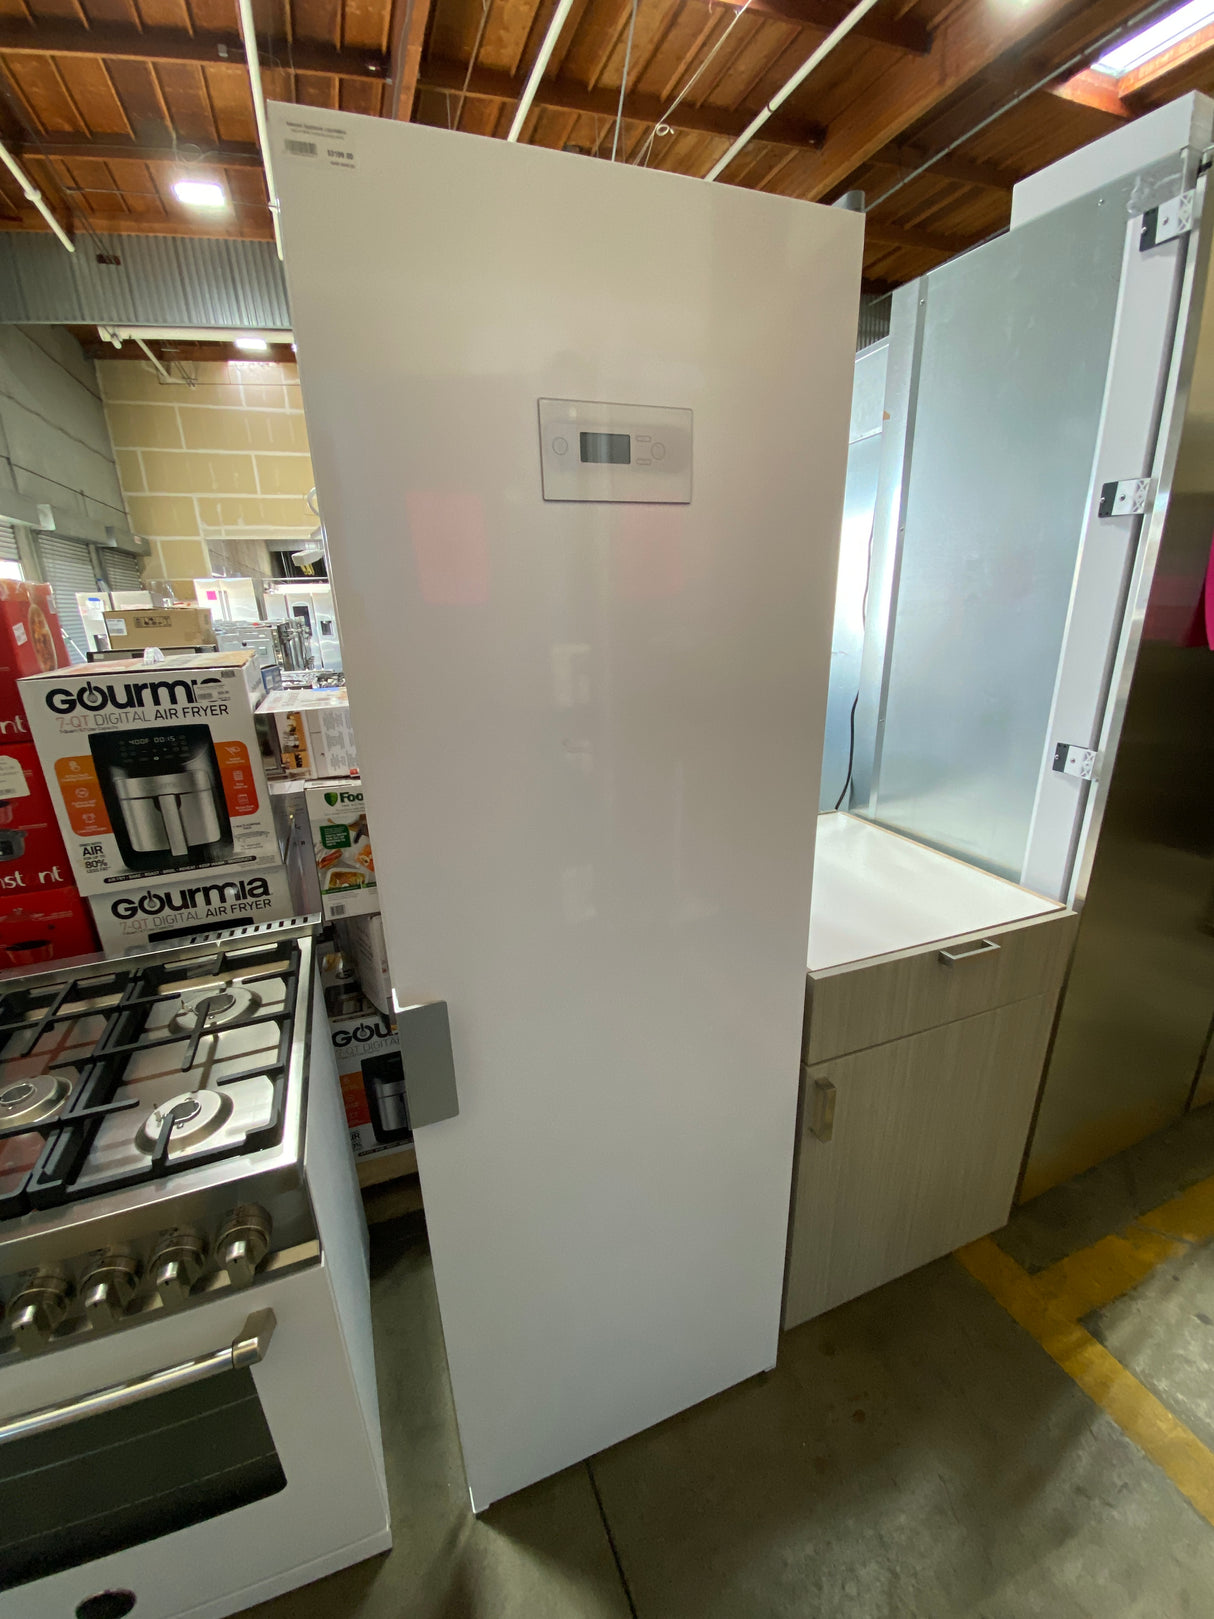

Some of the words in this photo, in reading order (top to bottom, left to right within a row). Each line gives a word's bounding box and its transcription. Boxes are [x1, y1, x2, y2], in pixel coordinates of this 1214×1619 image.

[45, 677, 222, 714] Gourm
[56, 714, 89, 729] 7-QT
[93, 711, 151, 727] DIGITAL
[154, 707, 179, 721] AIR
[182, 704, 229, 719] FRYER
[83, 845, 104, 856] AIR
[85, 859, 108, 869] 80%
[111, 877, 270, 920] Gourmia
[119, 918, 149, 932] 7-QT
[153, 910, 203, 927] DIGITAL
[205, 906, 228, 919] AIR
[231, 898, 272, 916] FRYER
